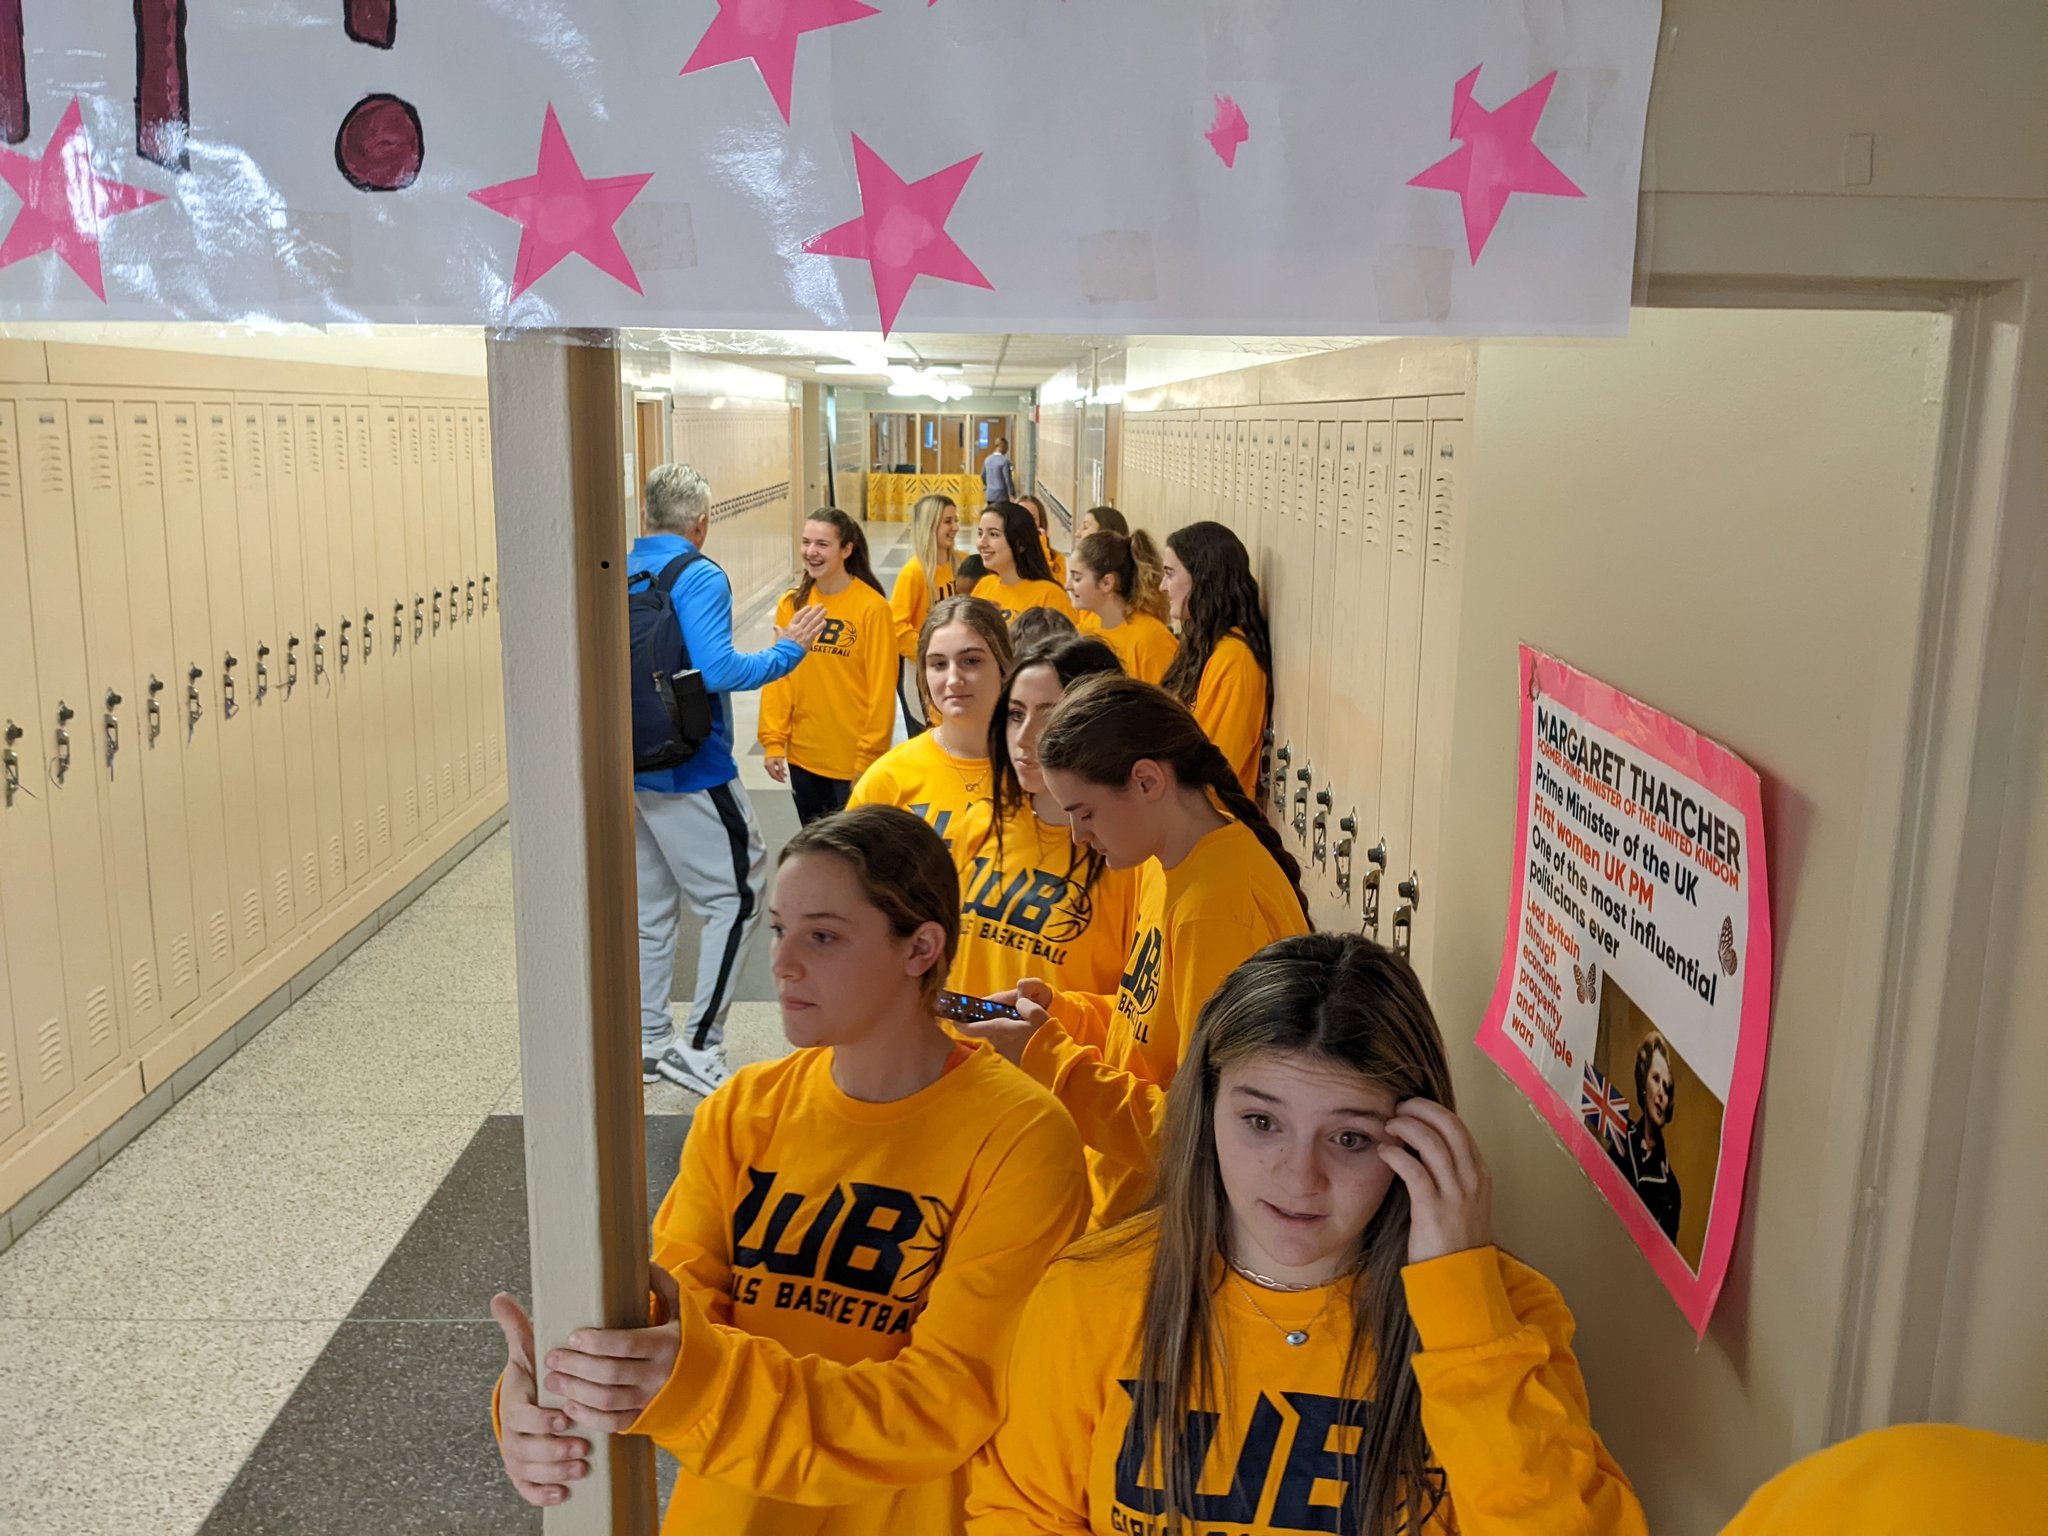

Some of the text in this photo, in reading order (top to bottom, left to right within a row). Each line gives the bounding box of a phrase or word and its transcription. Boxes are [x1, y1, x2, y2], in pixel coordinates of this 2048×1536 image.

[810, 644, 851, 657] SKETBALL
[817, 617, 845, 646] B
[1537, 705, 1741, 873] MARGARET THATCHER
[1537, 738, 1739, 892] FORMER PRIME MINISTER OF THE UNITED KINDOM
[1534, 793, 1655, 913] First women UK PM
[1536, 761, 1699, 907] Prime Minister of the UK
[979, 922, 1068, 966] BASKETBALL
[1525, 917, 1557, 968] through
[1526, 890, 1581, 962] Lead Britain
[1529, 859, 1620, 960] politicians ever
[1532, 824, 1718, 1006] One of the most influential
[1518, 966, 1563, 1032] prosperity
[1522, 943, 1563, 1001] economic
[1511, 1013, 1535, 1049] wars
[1515, 989, 1574, 1068] and multiple
[774, 1282, 912, 1335] BASKETBA
